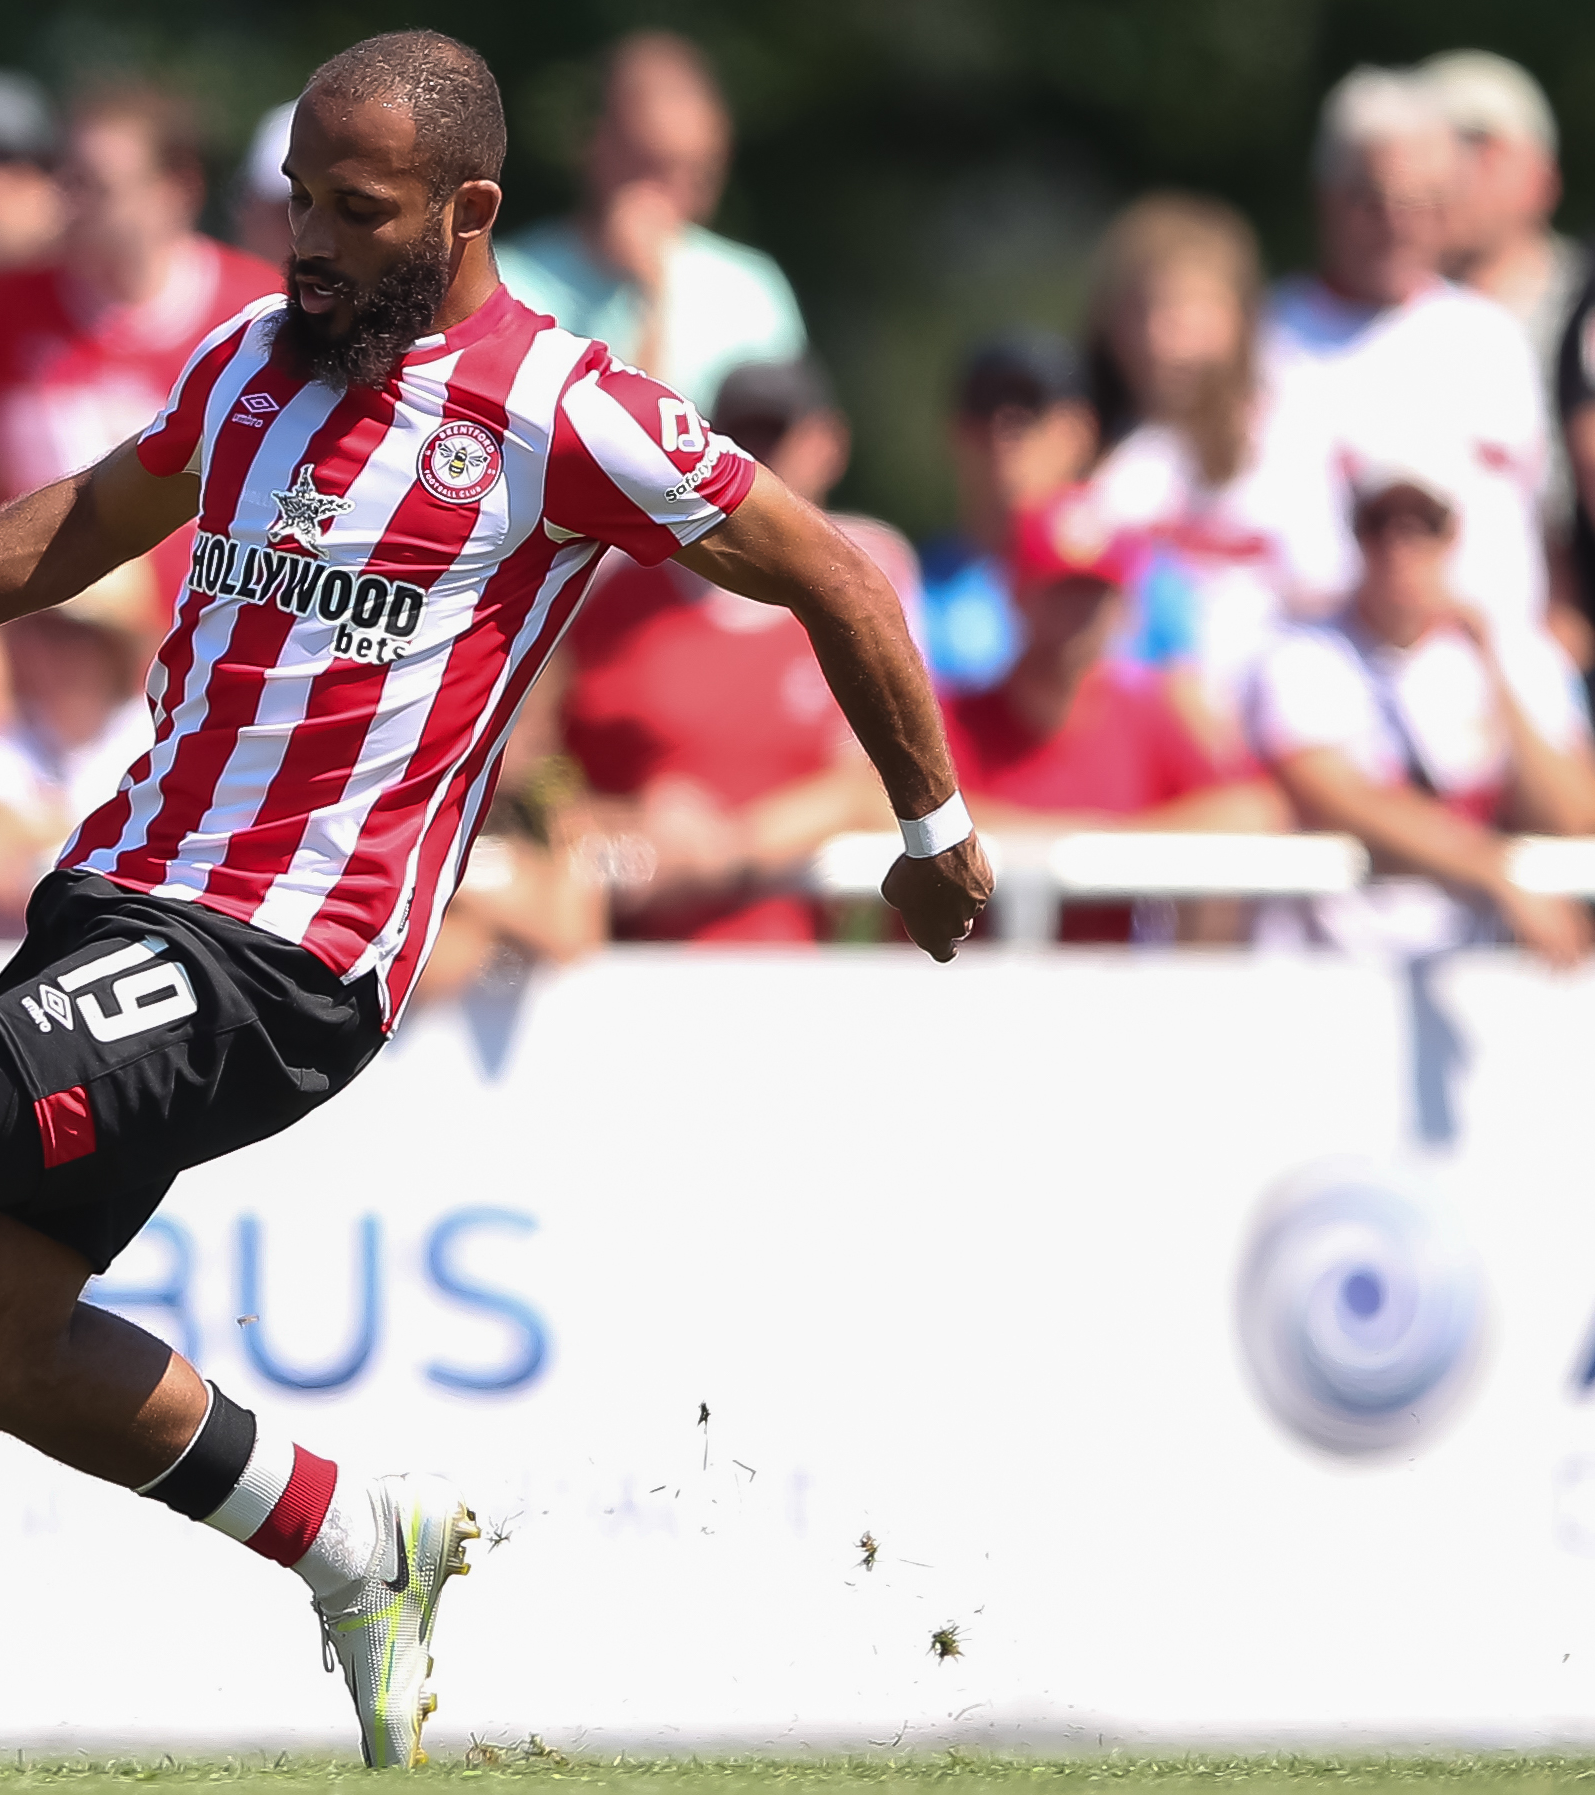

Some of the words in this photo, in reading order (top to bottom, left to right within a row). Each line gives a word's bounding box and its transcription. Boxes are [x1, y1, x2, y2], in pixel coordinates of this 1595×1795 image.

[438, 425, 495, 453] BRENTFORD
[424, 469, 457, 498] FOOTBALL
[458, 486, 482, 498] CLUB
[187, 534, 426, 638] HOLLYWOOD
[333, 622, 408, 664] bets
[56, 934, 199, 1043] 19
[20, 995, 52, 1033] umbro
